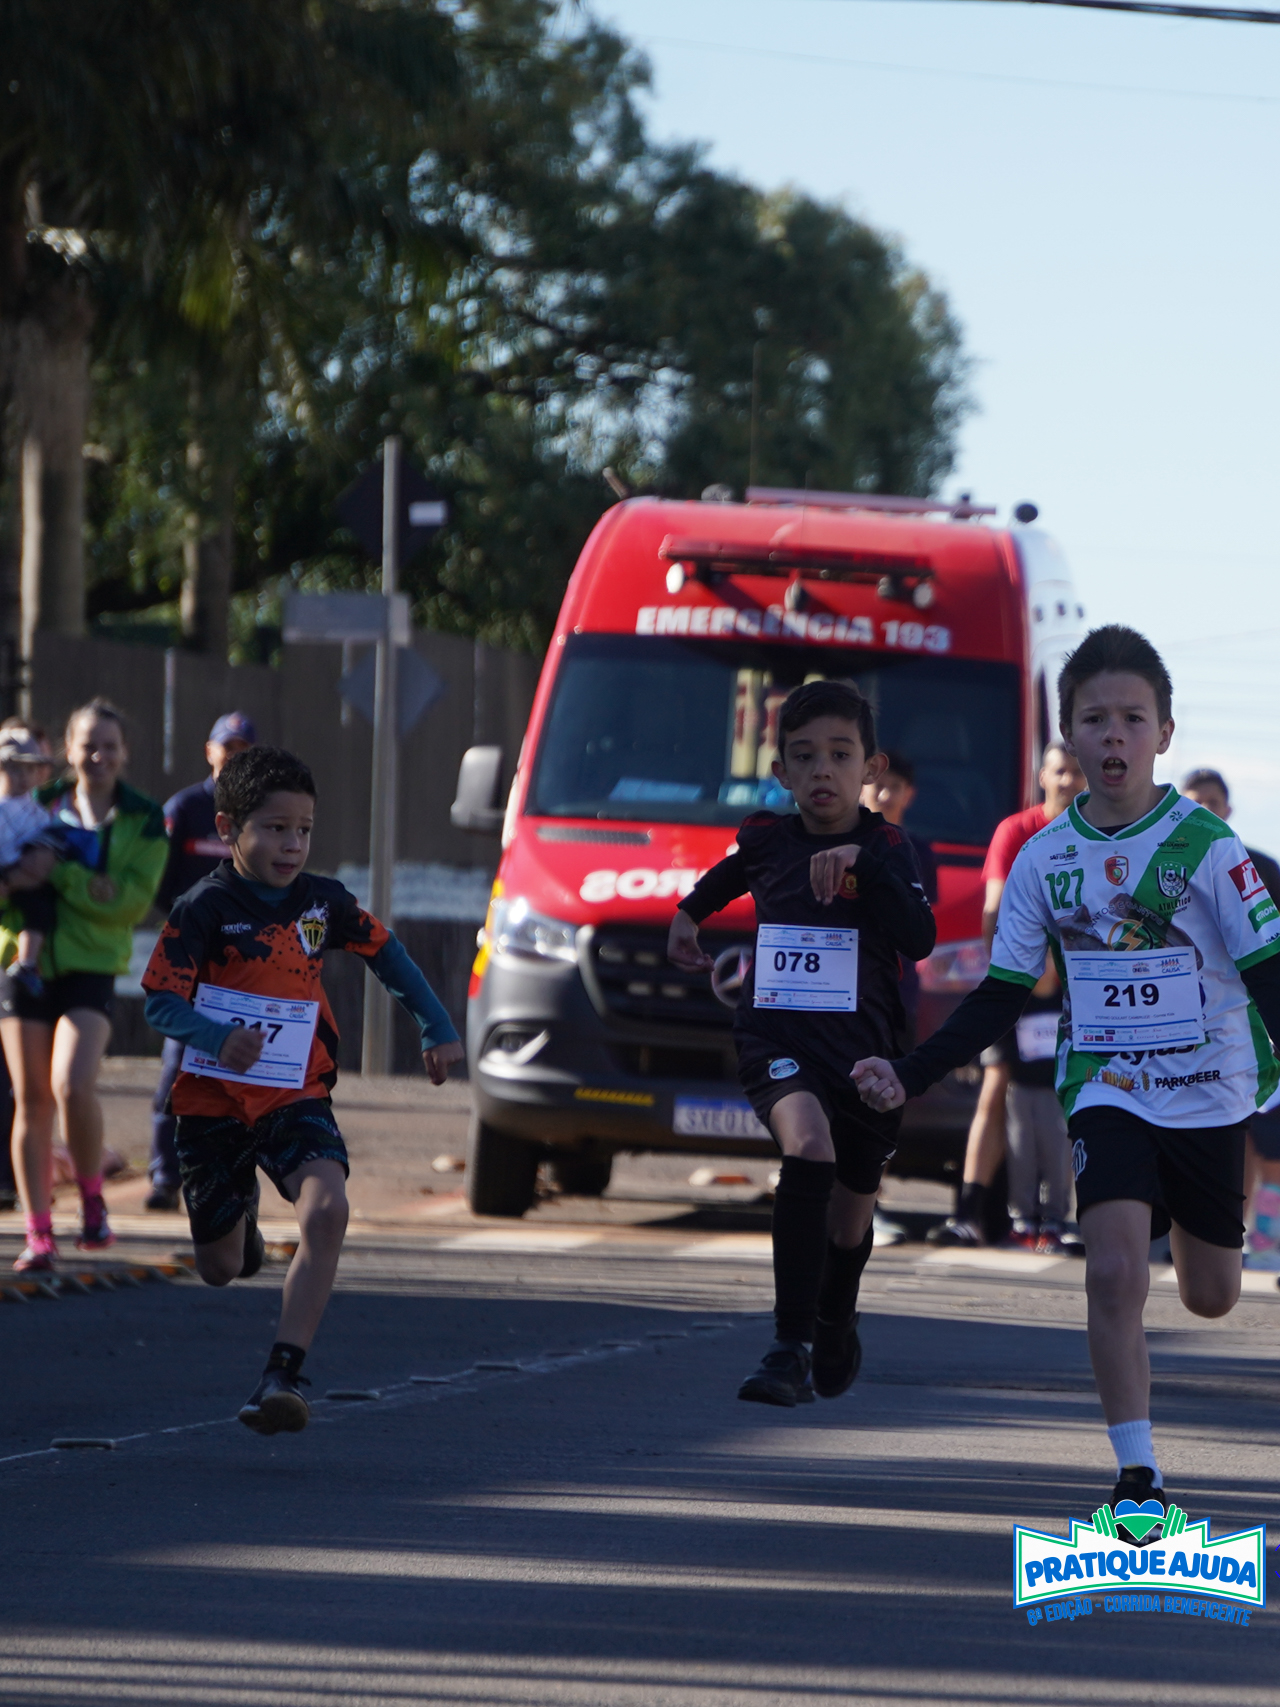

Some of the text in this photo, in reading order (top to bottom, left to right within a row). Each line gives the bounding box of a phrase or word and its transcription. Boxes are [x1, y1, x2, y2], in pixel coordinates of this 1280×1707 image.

[881, 620, 950, 653] 193
[1045, 868, 1084, 910] 127
[774, 951, 820, 973] 078
[1103, 983, 1160, 1007] 219
[1154, 1069, 1221, 1091] PARKBEER
